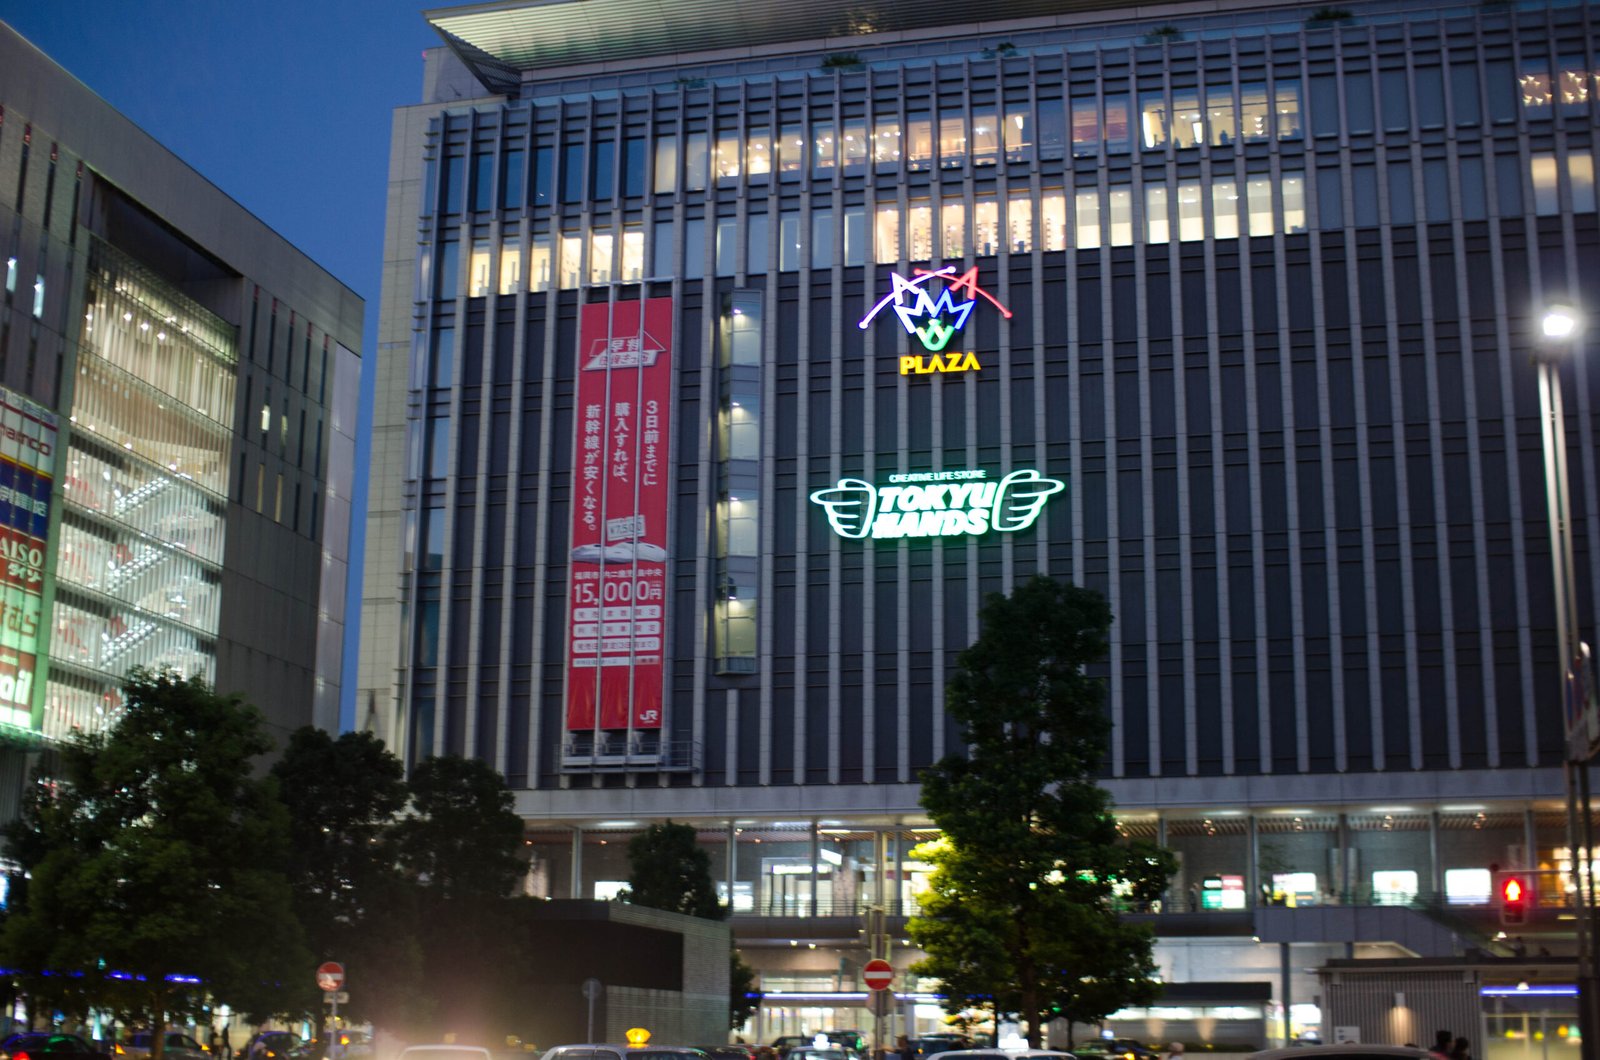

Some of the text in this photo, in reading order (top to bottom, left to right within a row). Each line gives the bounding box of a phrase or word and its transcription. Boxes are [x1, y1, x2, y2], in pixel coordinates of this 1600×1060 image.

[900, 351, 981, 375] PLAZA
[612, 402, 631, 483] 購入すれば、
[644, 400, 659, 486] 3日前までに
[582, 404, 601, 532] 新幹線が安くなる。
[889, 470, 986, 483] CREATIVE LIFE STORE
[878, 482, 998, 512] TOKYU
[872, 508, 990, 539] HANDS
[574, 580, 662, 604] 15,000円
[640, 710, 658, 720] JR
